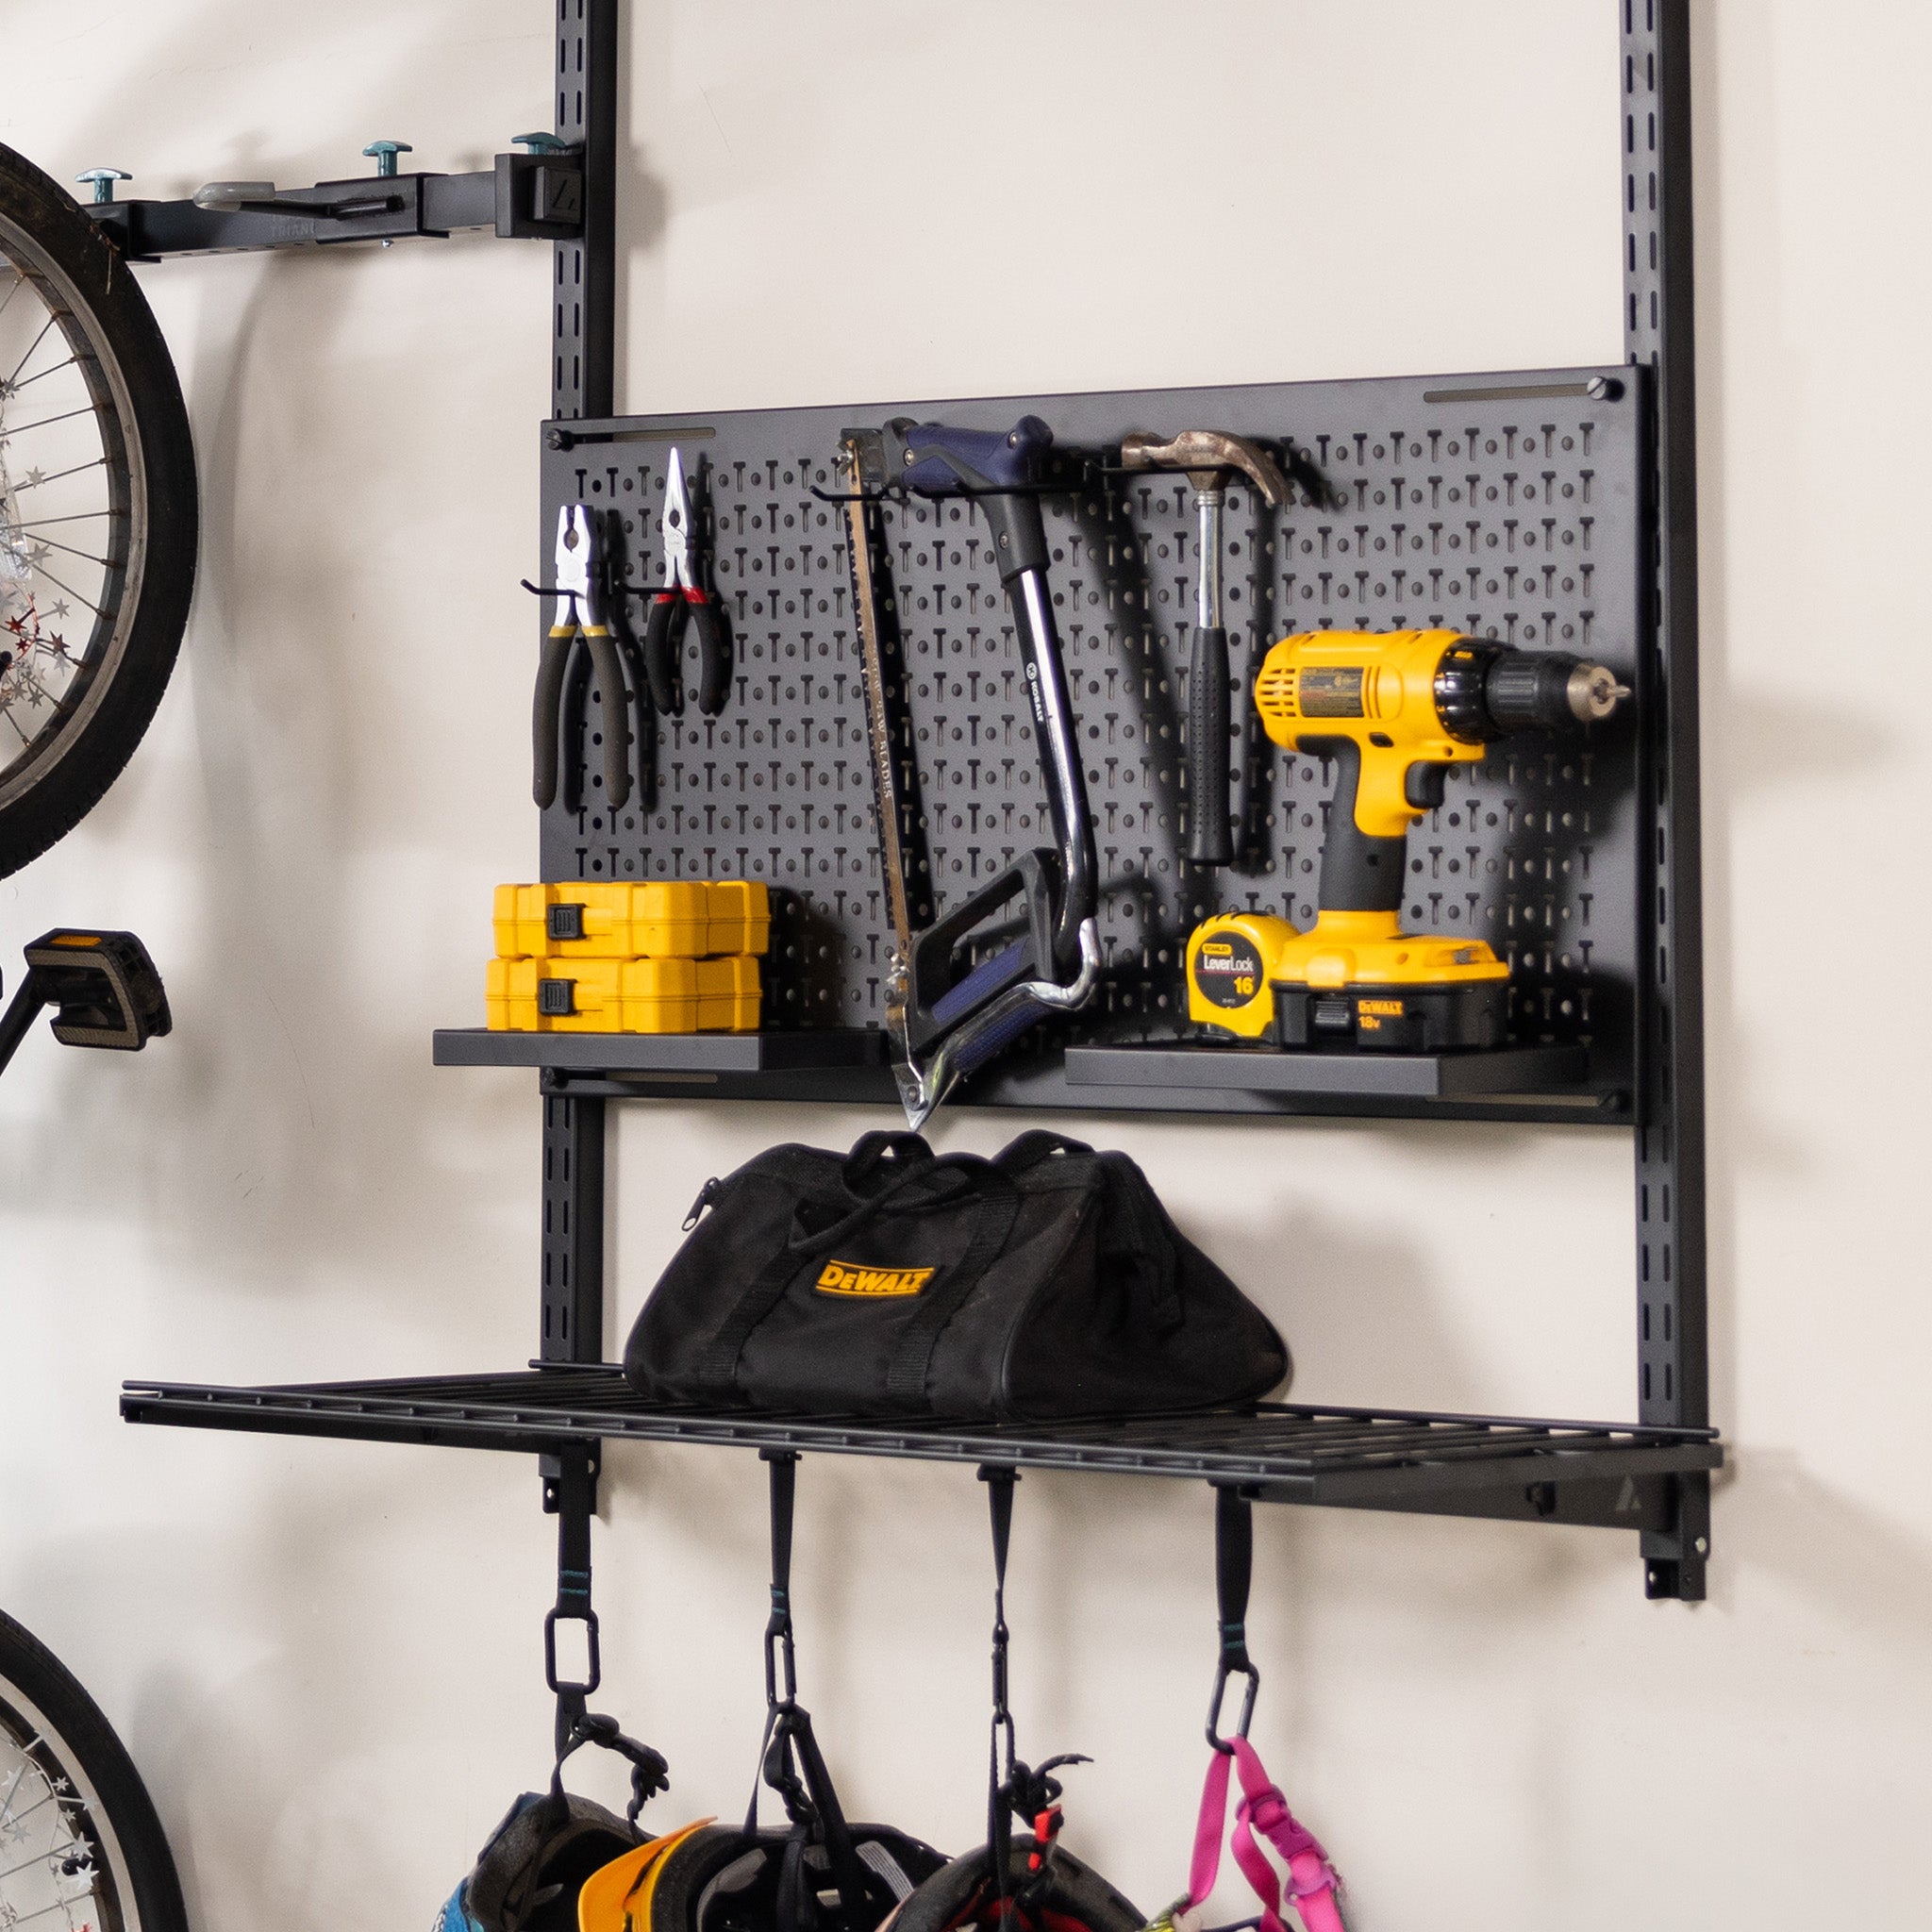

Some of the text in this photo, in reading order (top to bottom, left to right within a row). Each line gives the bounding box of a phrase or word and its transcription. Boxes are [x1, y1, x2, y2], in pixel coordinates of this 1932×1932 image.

[1030, 680, 1044, 723] KOBALT
[880, 741, 892, 799] BLADES
[1204, 954, 1254, 973] LeverLock
